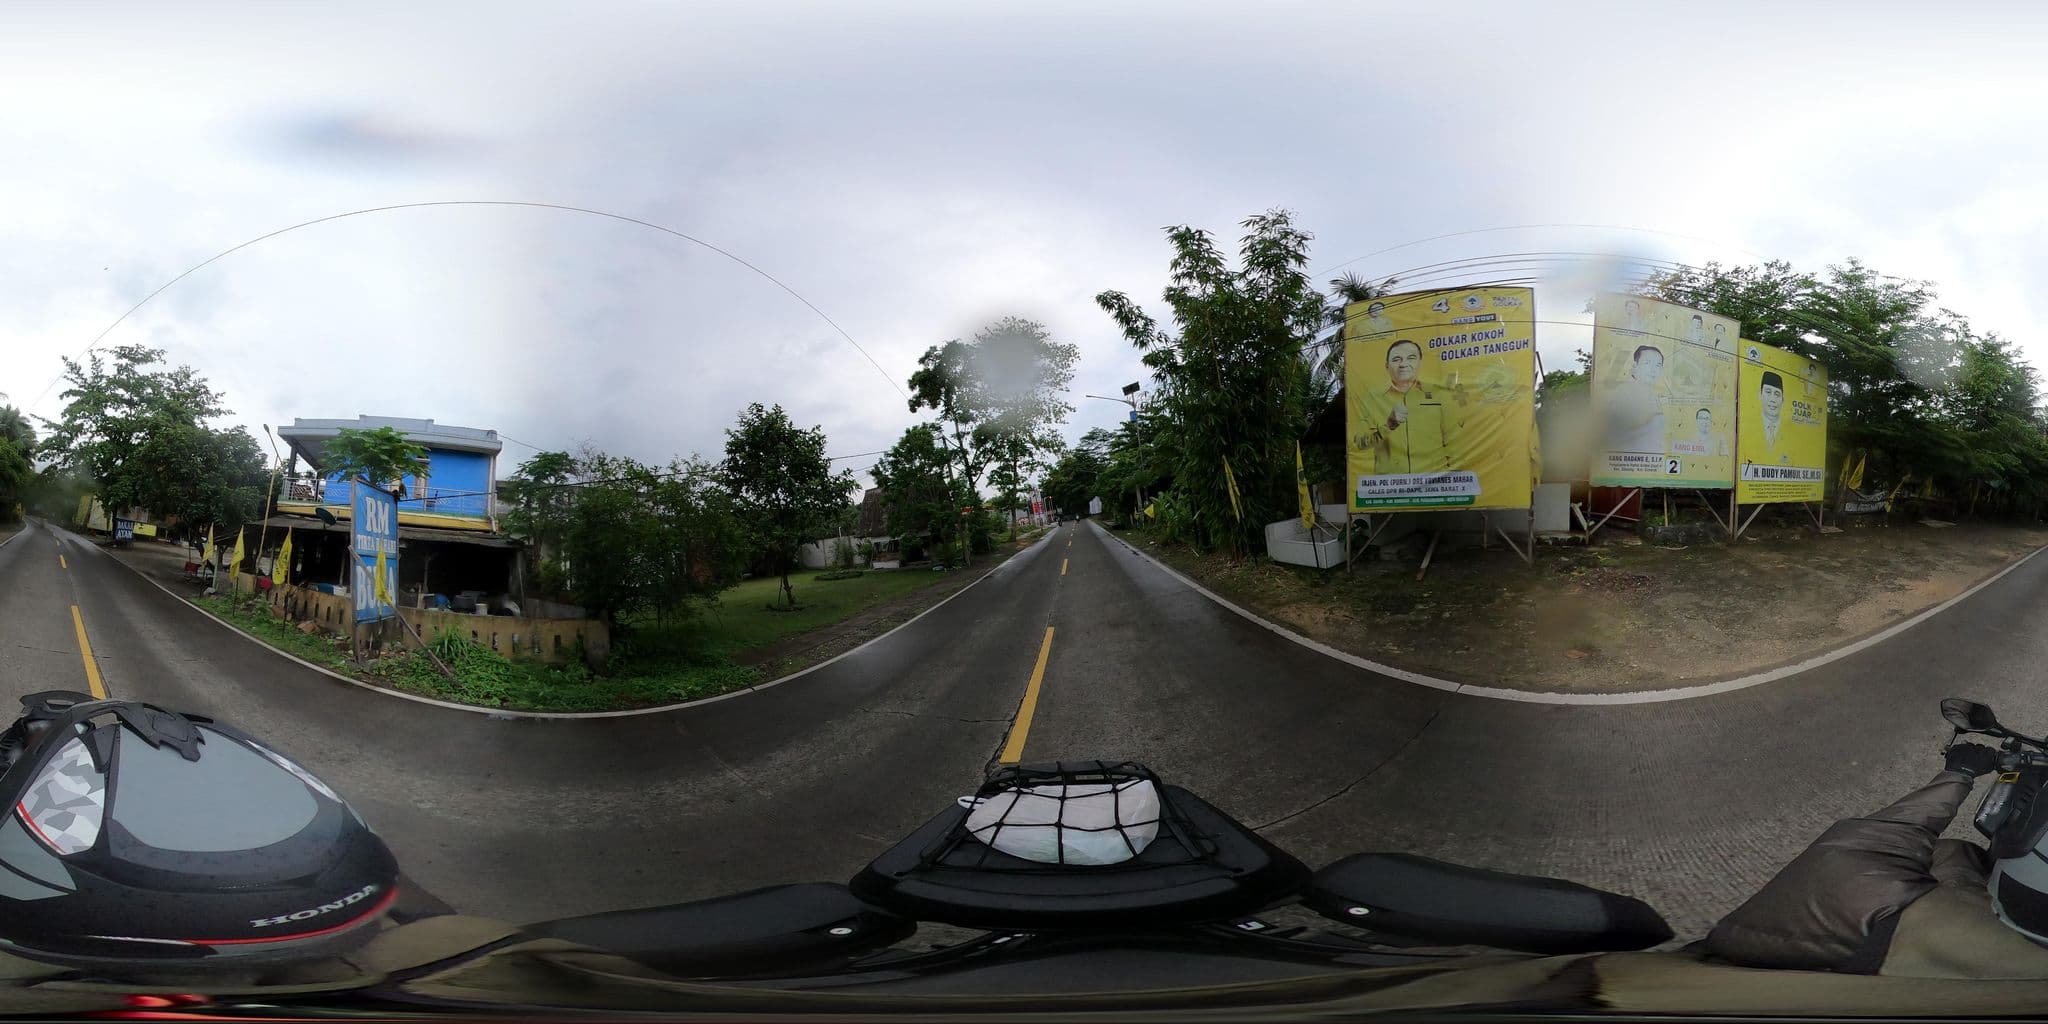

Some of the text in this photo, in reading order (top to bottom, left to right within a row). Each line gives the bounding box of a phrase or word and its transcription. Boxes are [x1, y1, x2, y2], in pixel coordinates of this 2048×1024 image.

[1429, 329, 1505, 349] GOLKAR KOKOH
[1441, 340, 1529, 361] GOLKAR TANGGUH
[1669, 460, 1678, 473] 2
[1754, 468, 1760, 478] H.
[1762, 468, 1779, 479] DUDY
[365, 497, 389, 535] RM
[356, 565, 396, 610] BUA
[250, 884, 378, 928] HONDA
